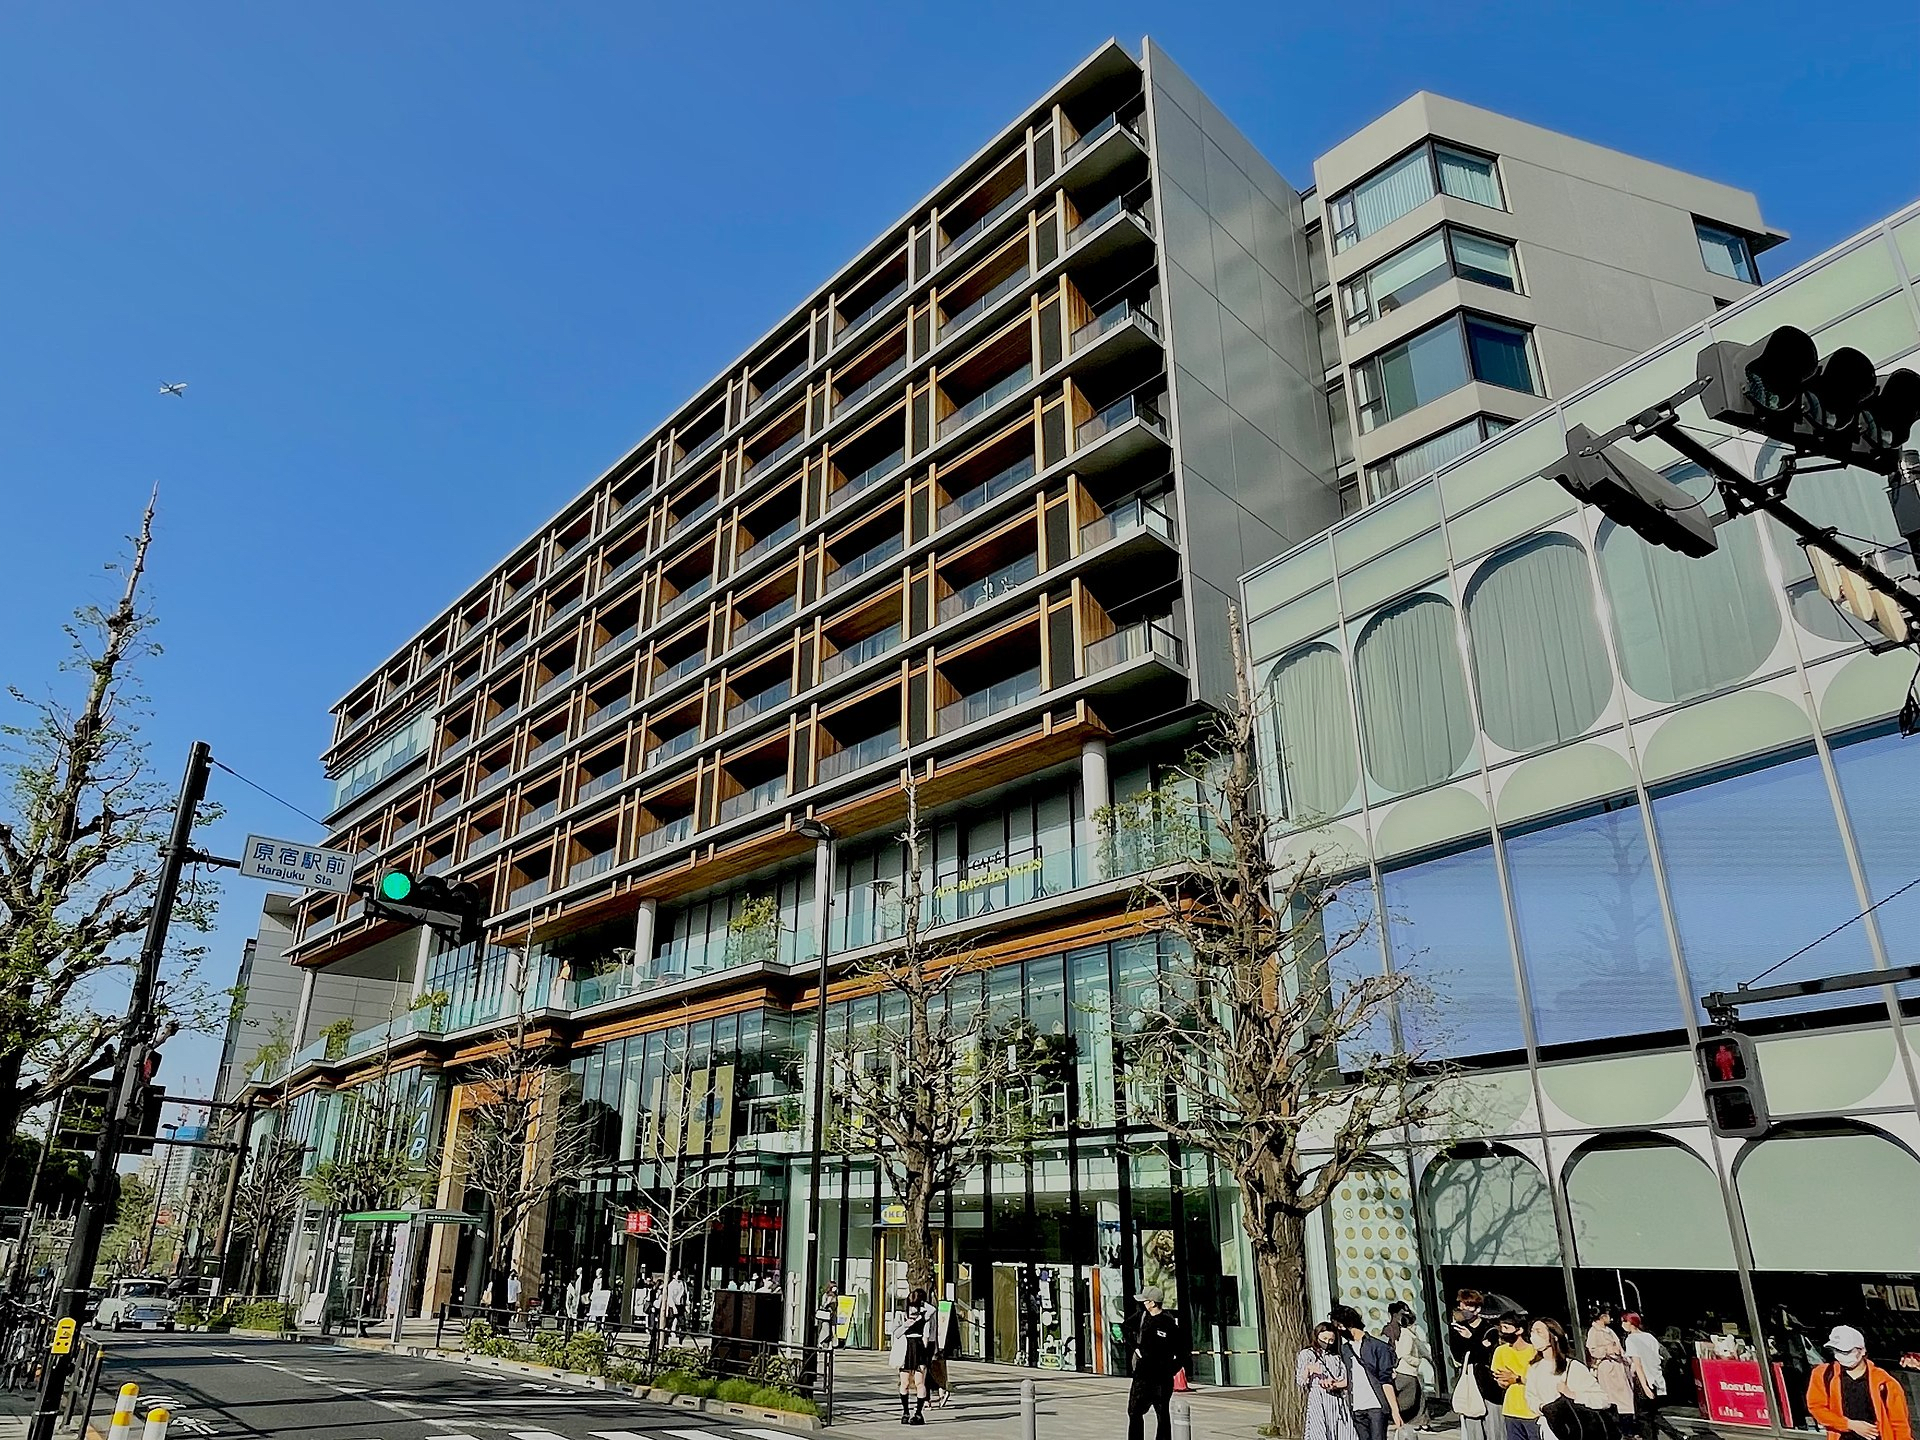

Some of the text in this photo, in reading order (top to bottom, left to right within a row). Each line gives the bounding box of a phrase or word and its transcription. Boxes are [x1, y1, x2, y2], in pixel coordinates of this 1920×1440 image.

[253, 842, 346, 875] 原宿駅前
[256, 863, 305, 881] Harajuku
[883, 1210, 906, 1219] IKE
